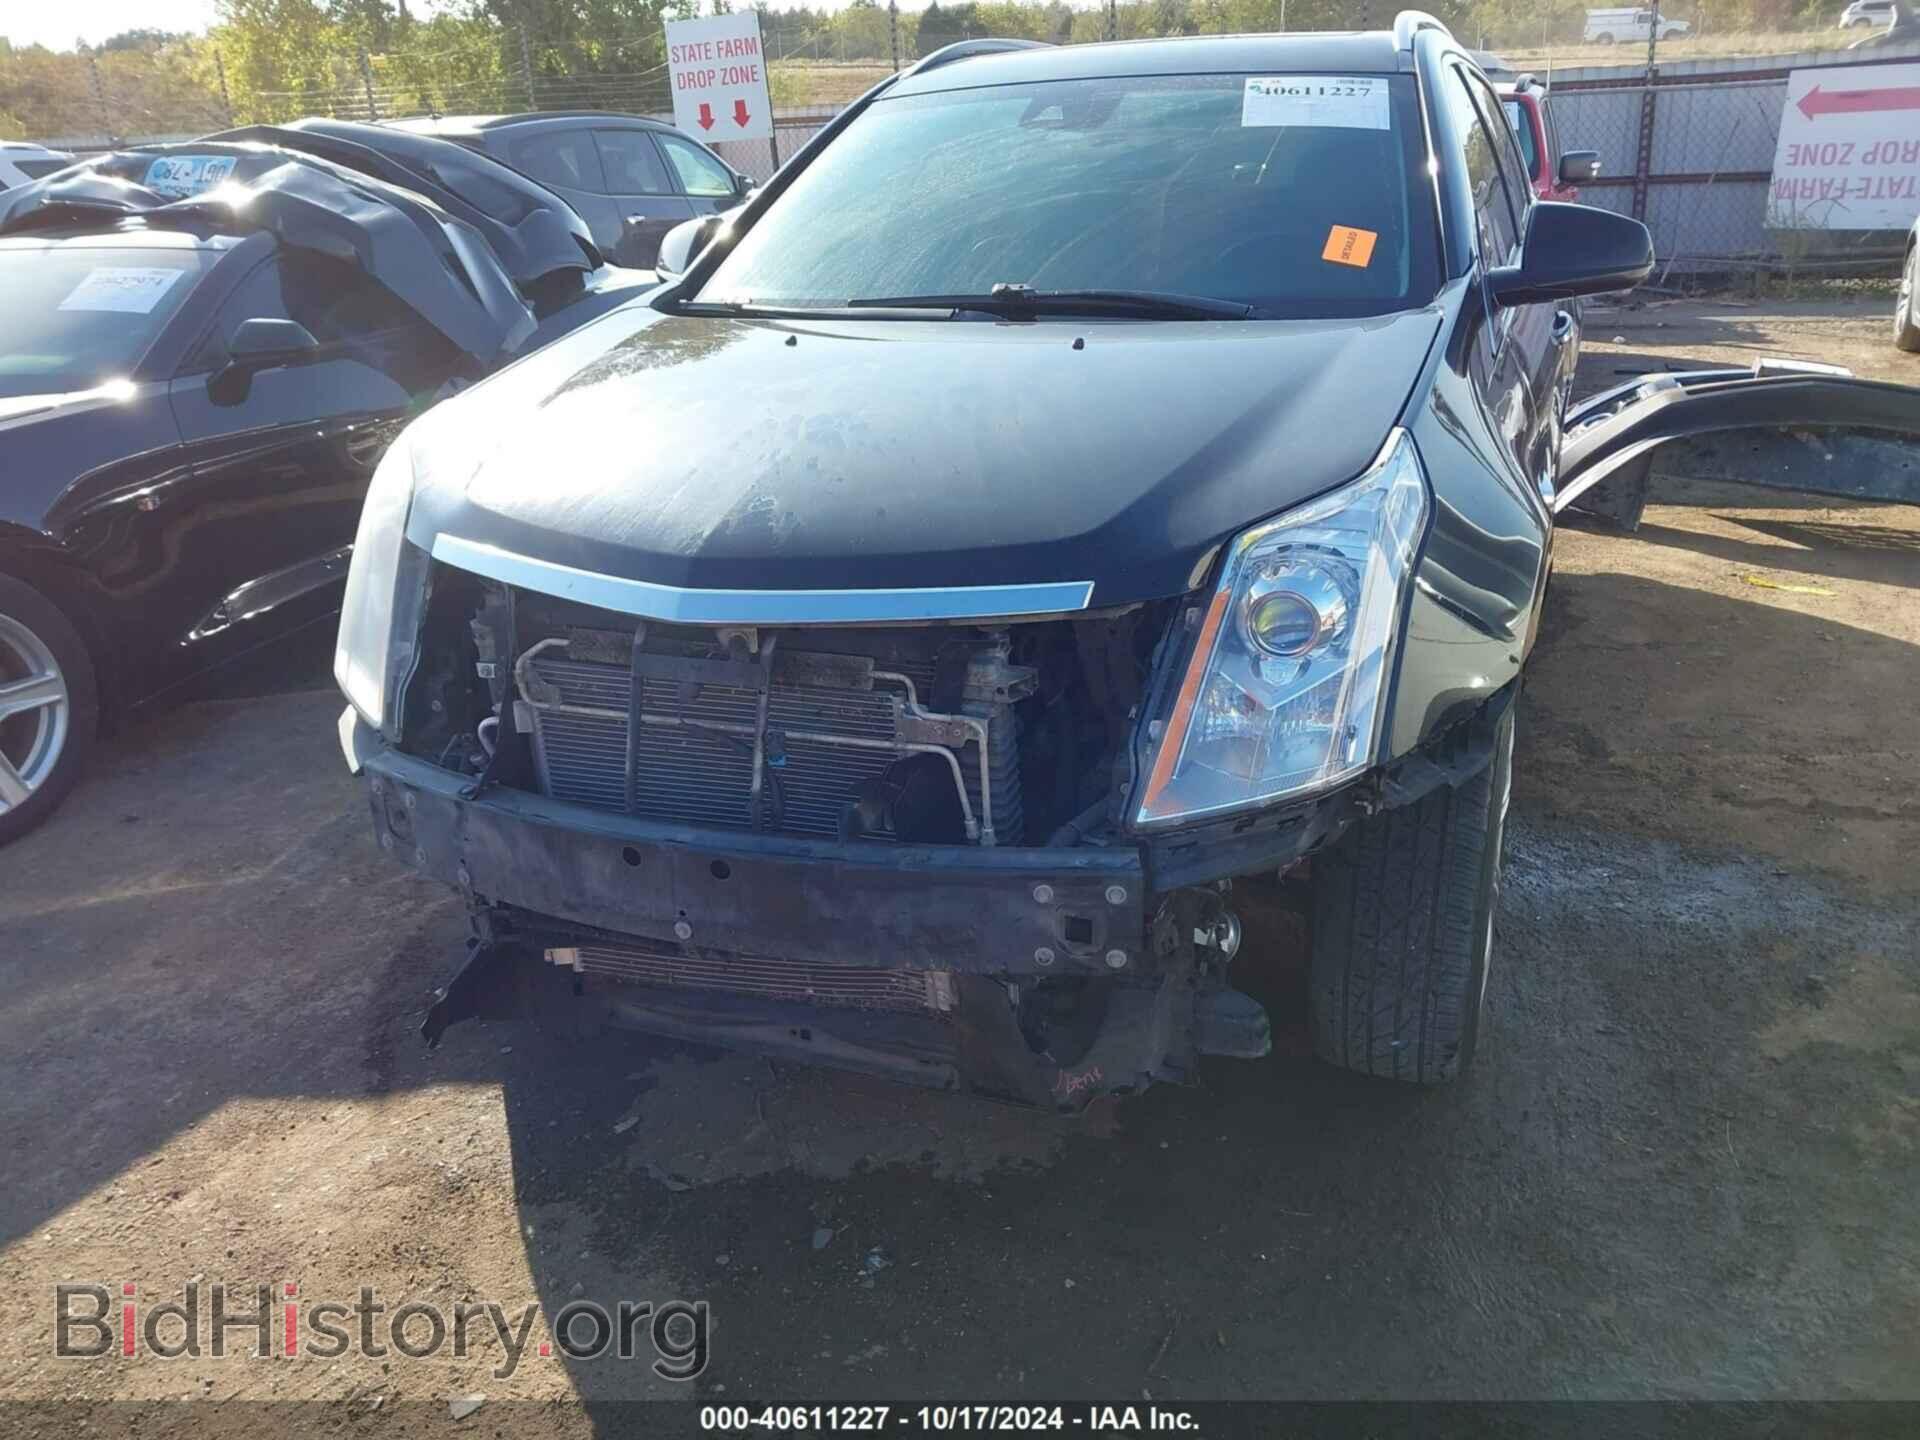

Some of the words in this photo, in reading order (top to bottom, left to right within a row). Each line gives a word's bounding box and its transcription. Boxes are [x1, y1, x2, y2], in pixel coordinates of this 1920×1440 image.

[671, 42, 713, 64] STATE
[716, 37, 758, 59] FARM
[677, 69, 716, 90] DROP
[720, 65, 760, 86] ZONE
[1261, 86, 1371, 97] 40611227
[1786, 142, 1856, 167] ZONE
[1862, 140, 1920, 165] ROP
[1775, 176, 1849, 200] FARM
[1855, 175, 1920, 199] TATE
